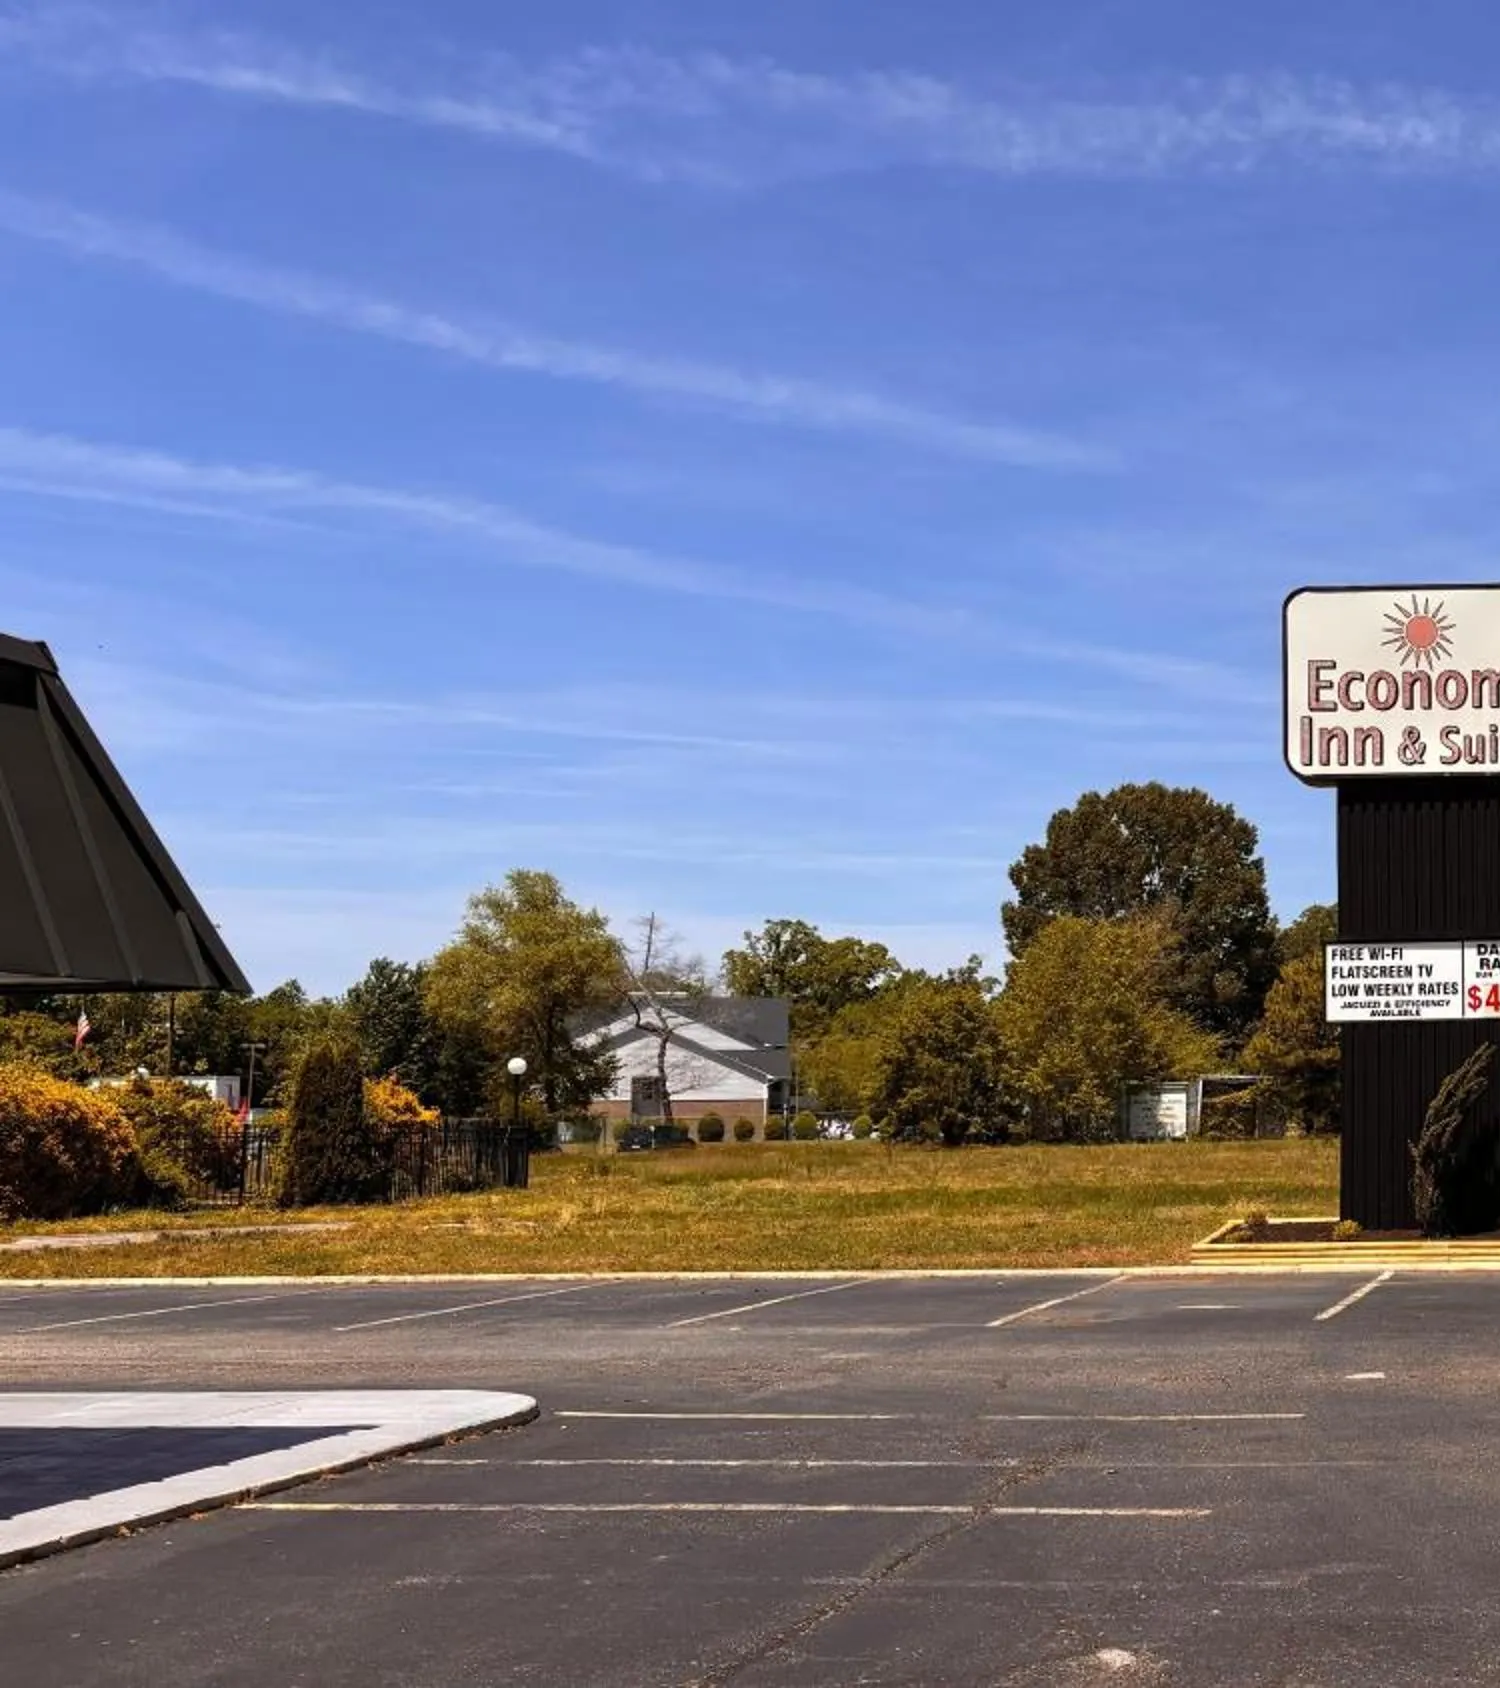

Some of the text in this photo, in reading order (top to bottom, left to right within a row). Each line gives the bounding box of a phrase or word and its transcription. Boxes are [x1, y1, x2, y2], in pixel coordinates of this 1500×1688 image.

[1300, 716, 1385, 767] Inn
[1397, 725, 1427, 766] &
[1331, 947, 1403, 961] FREE WI-FI
[1331, 964, 1433, 979] FLATSCREEN TV
[1331, 982, 1459, 997] LOW WEEKLY RATES
[1340, 1001, 1381, 1009] JACUZZI
[1394, 999, 1451, 1008] EFFICIENCY
[1369, 1009, 1421, 1017] AVAILABLE
